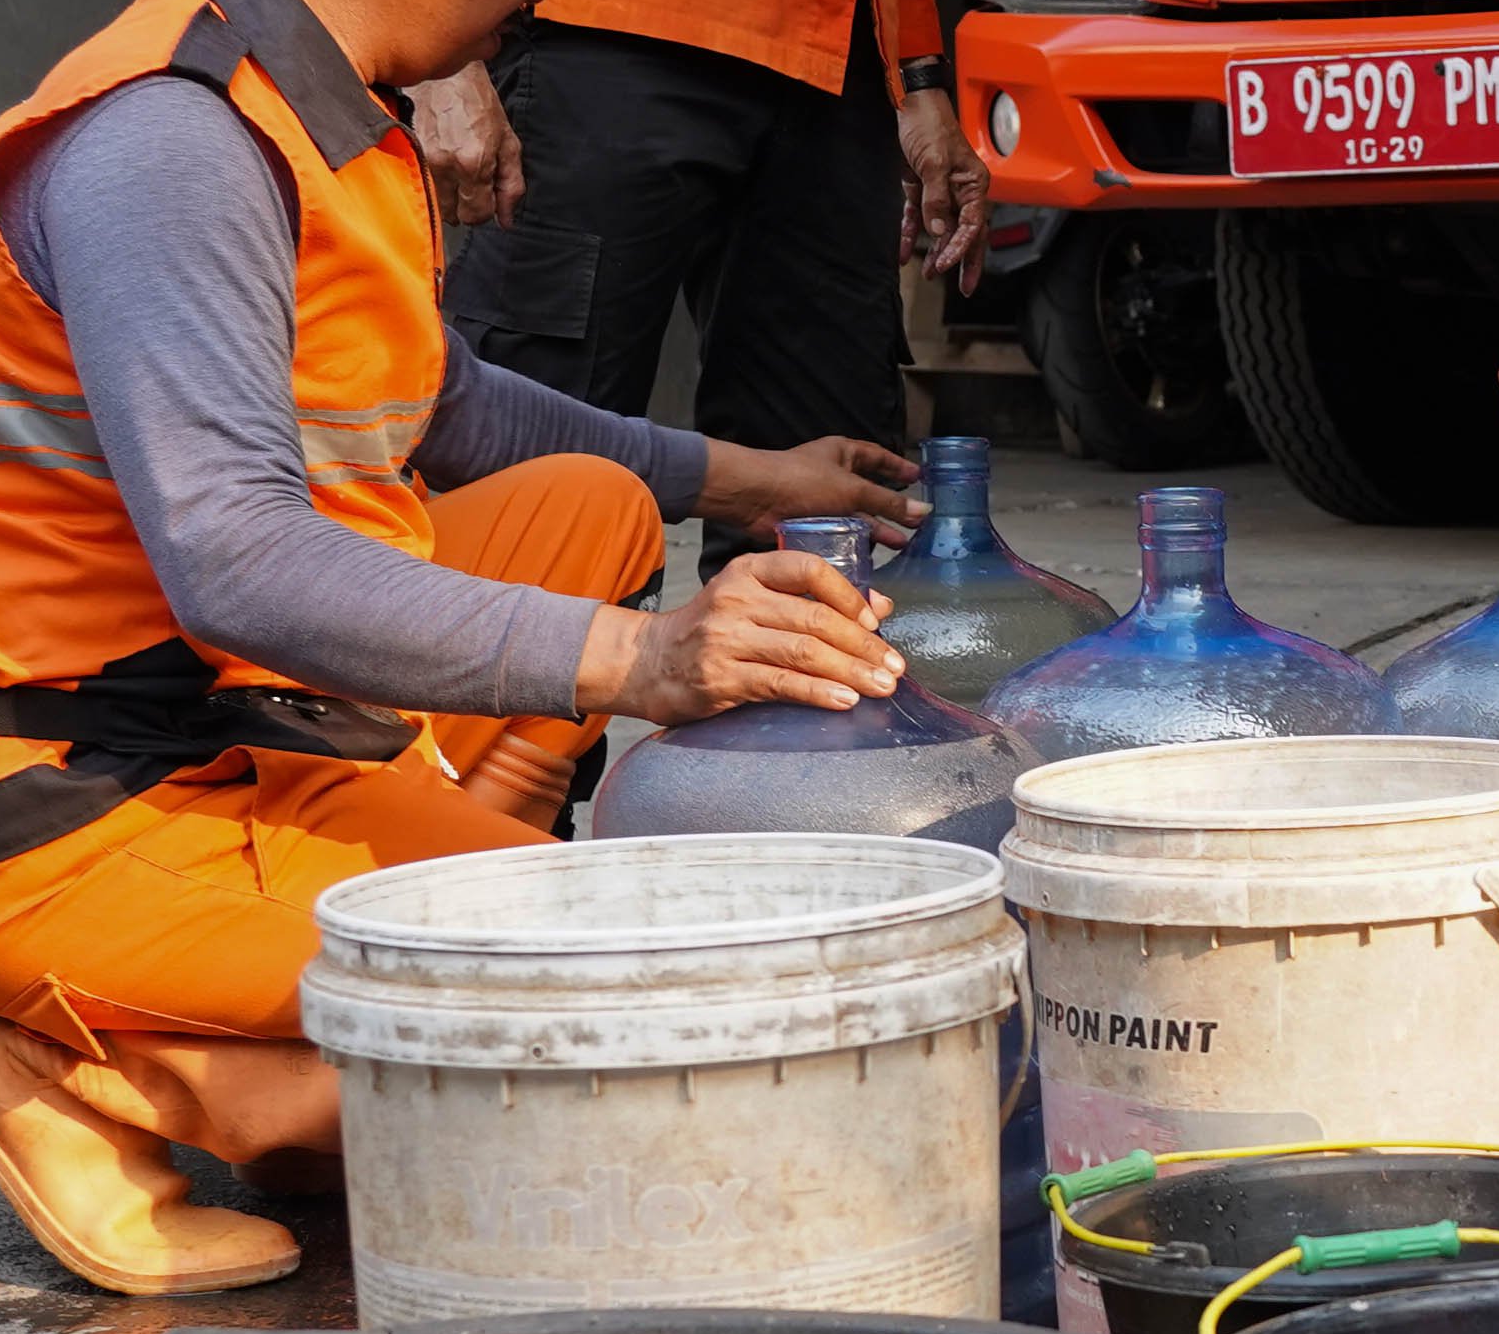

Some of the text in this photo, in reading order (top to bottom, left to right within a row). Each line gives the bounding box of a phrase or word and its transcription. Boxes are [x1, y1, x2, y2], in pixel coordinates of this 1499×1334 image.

[1237, 70, 1268, 136] B
[1293, 61, 1415, 133] 9599
[1109, 1014, 1218, 1054] PAINT
